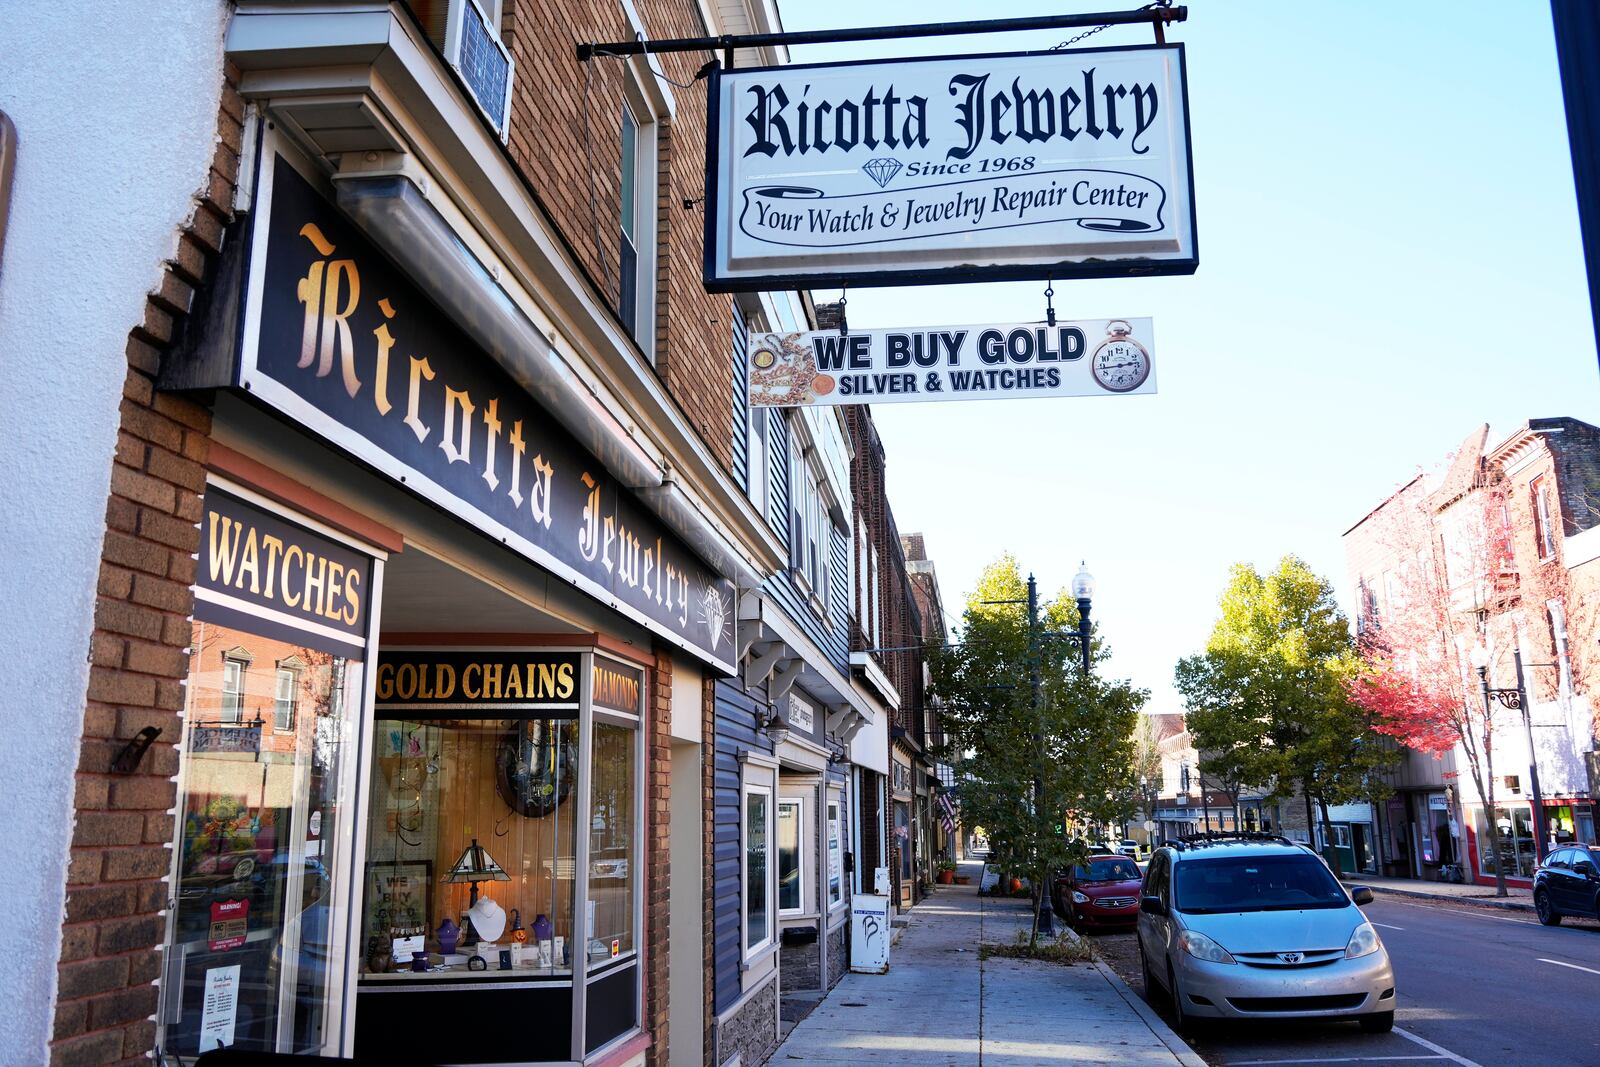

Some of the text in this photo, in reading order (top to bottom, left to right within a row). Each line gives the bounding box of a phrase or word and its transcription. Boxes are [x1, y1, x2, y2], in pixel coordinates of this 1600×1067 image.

[744, 67, 1159, 160] Ricotta Jewelry
[905, 156, 1036, 177] Since 1968
[755, 180, 1149, 234] Your Watch & Jewelry Repair Center
[811, 326, 1087, 372] WE BUY GOLD
[839, 366, 1061, 397] SILVER & WATCHES
[297, 223, 689, 629] Ricotta Jewelry
[208, 510, 361, 626] WATCHES
[376, 662, 574, 700] GOLD CHAINS
[592, 665, 639, 712] DIAMONDS
[387, 877, 408, 888] WE
